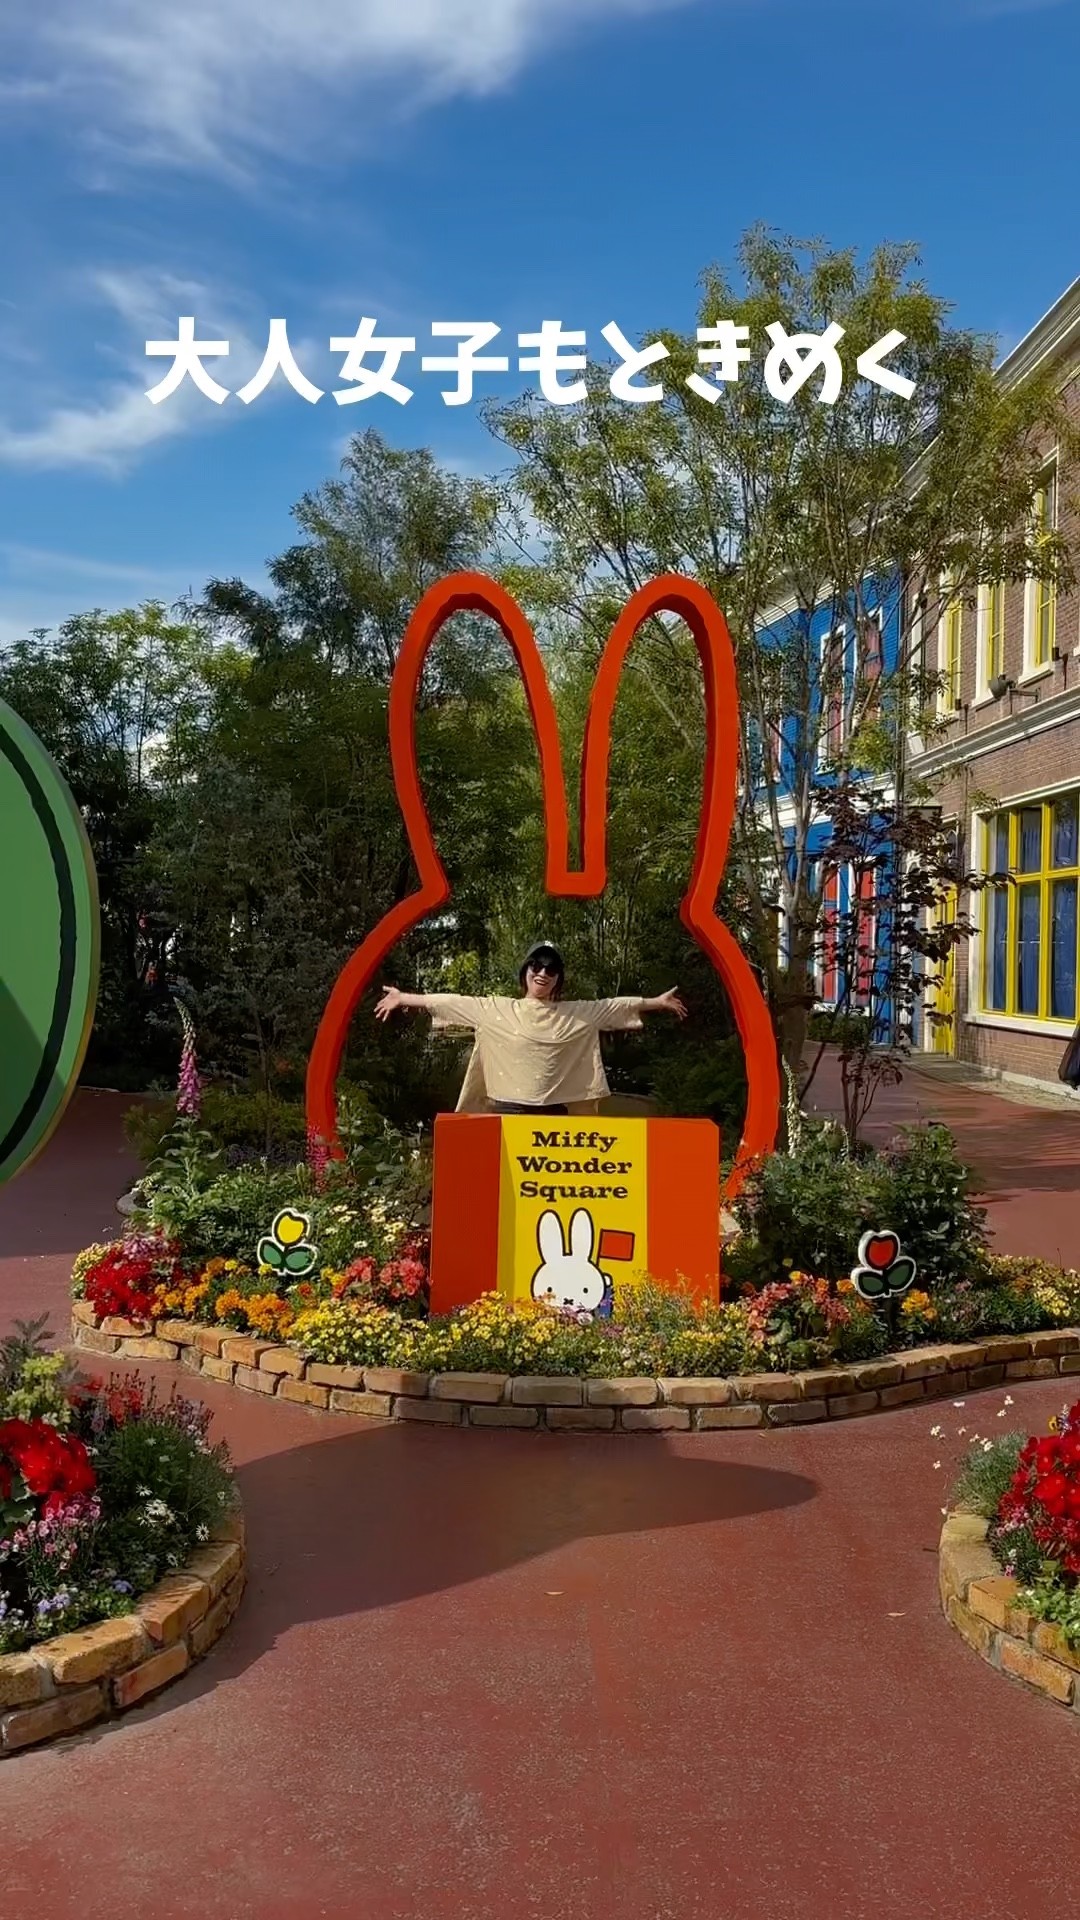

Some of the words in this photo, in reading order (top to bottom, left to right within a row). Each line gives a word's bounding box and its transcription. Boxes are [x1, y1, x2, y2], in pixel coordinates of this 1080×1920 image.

[531, 1131, 618, 1153] Miffy
[516, 1156, 633, 1174] Wonder
[519, 1180, 629, 1202] Square
